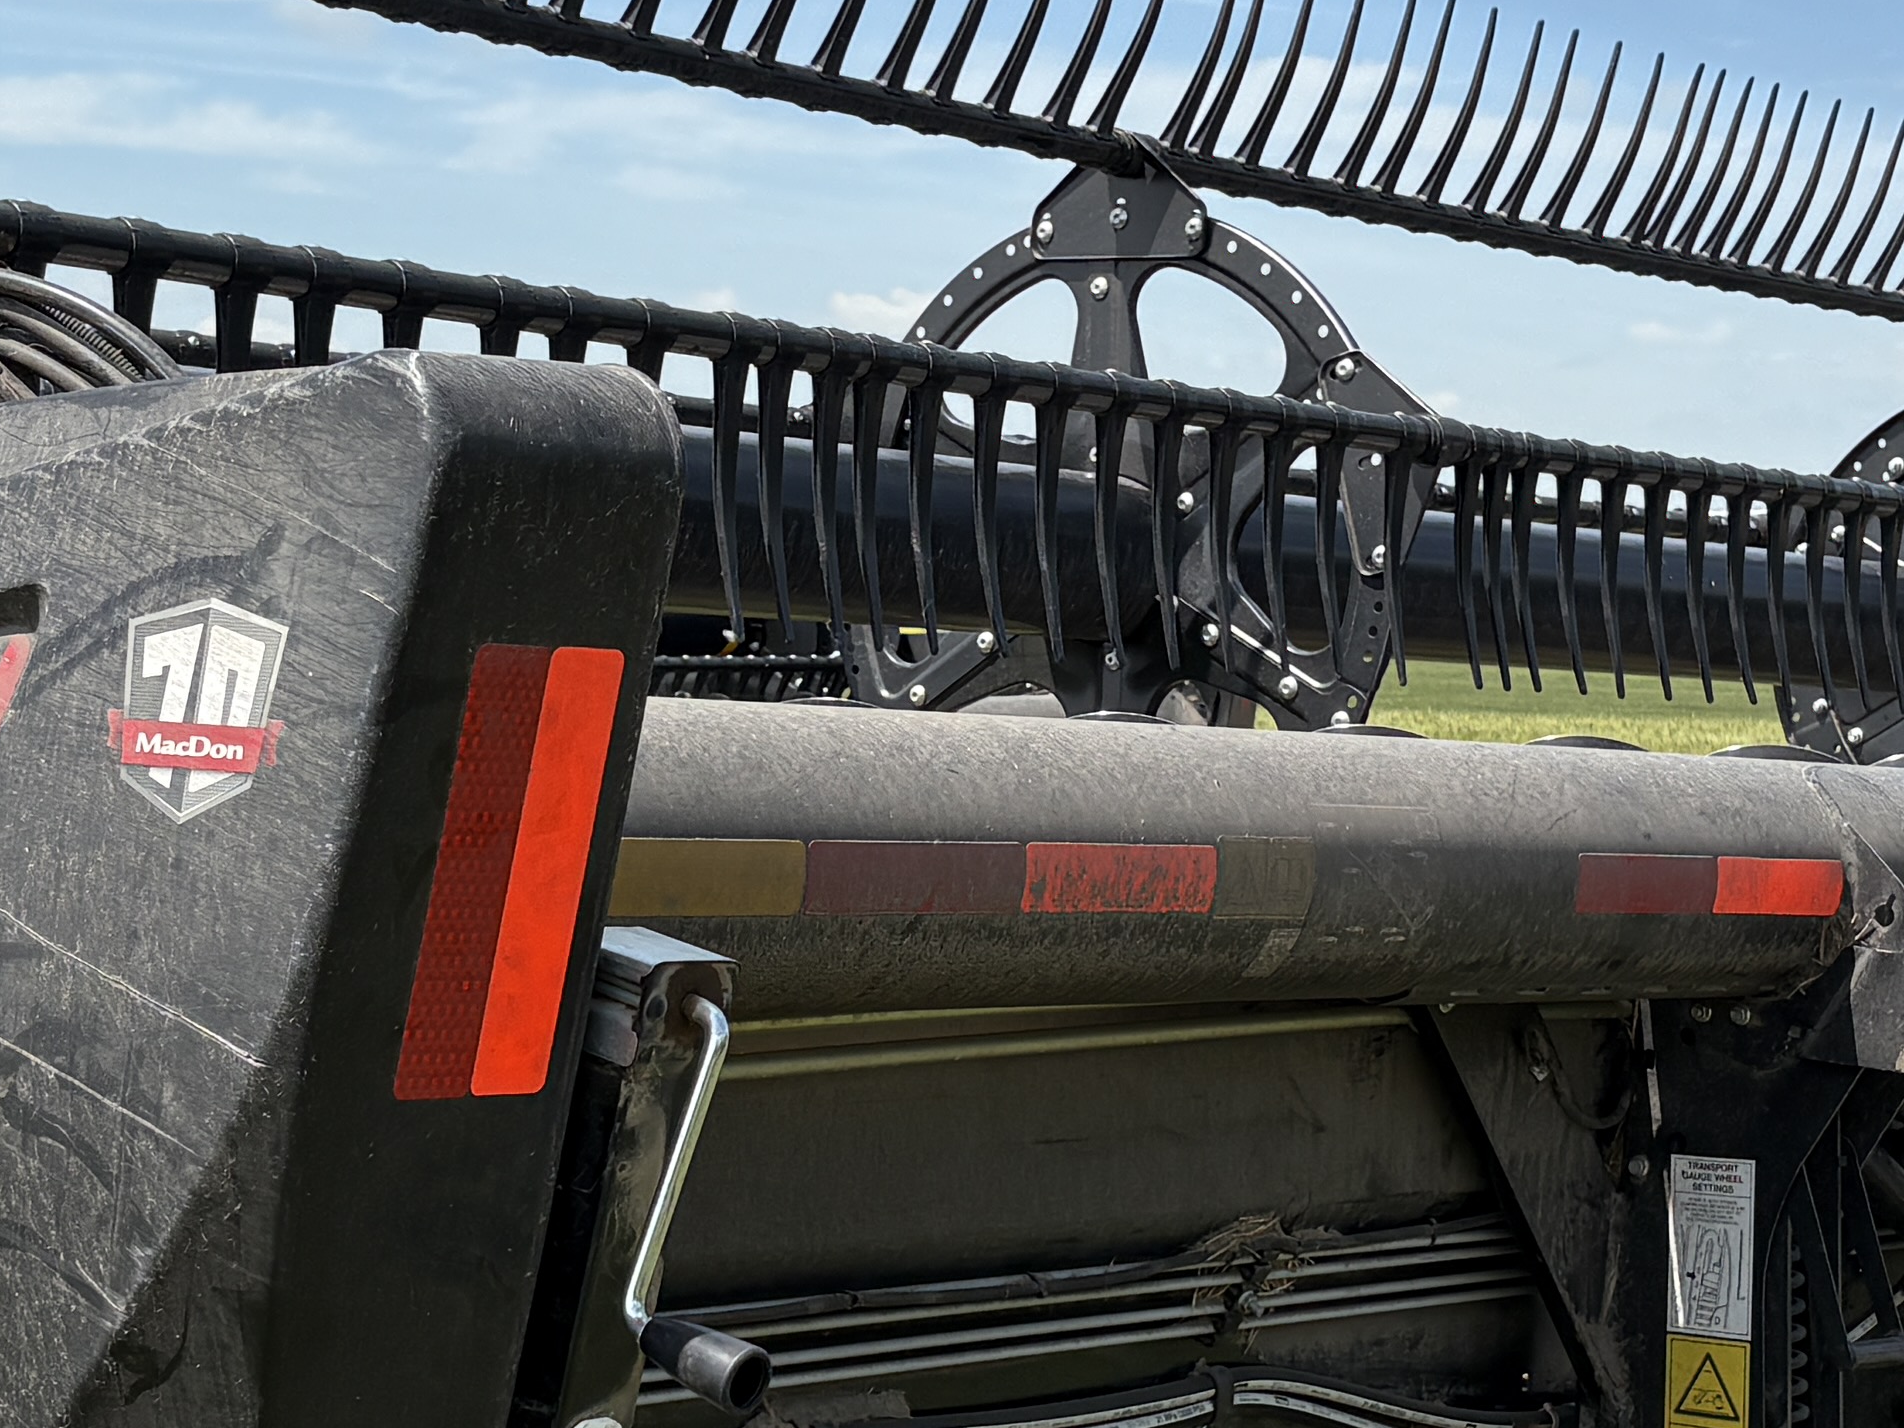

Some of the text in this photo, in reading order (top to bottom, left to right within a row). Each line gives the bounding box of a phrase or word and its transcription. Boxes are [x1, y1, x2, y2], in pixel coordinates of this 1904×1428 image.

[135, 732, 245, 760] MacDon
[1687, 1161, 1739, 1173] TRANSPORT
[1681, 1170, 1744, 1184] GAUGE WHEEL
[1692, 1182, 1735, 1194] SETTINGS
